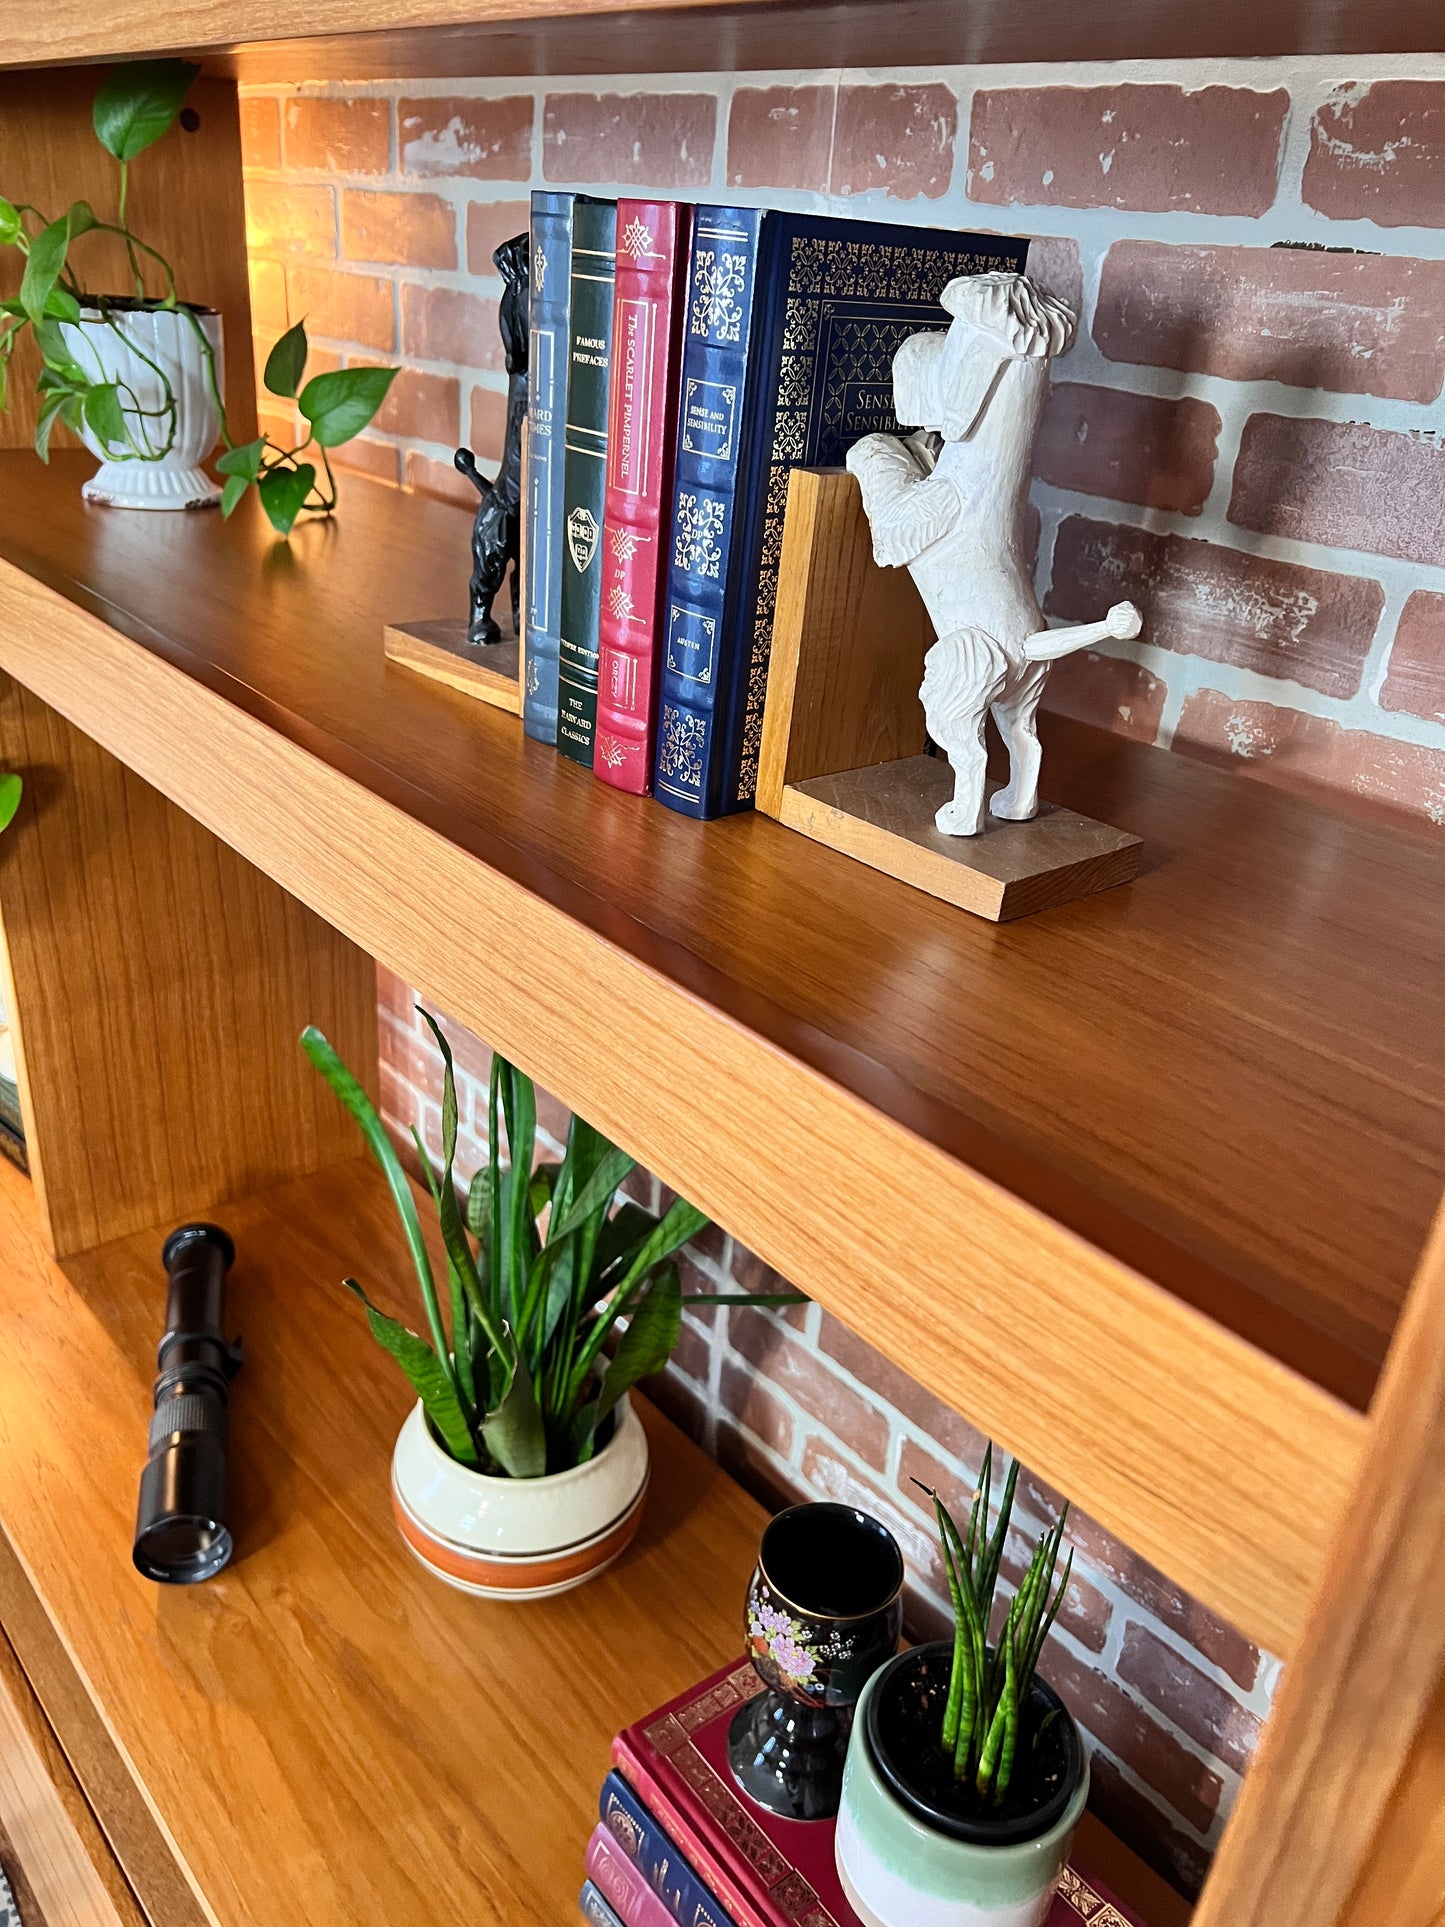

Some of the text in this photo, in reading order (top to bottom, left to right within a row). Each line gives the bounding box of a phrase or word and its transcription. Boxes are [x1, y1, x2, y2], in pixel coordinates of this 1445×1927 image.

[576, 335, 606, 350] FAMOUS
[572, 351, 609, 368] PREFACES
[624, 338, 636, 401] SCARLET
[690, 405, 725, 421] SENSE AND
[687, 418, 727, 435] SENSIBILITY
[621, 404, 633, 479] PIMPERNEL
[676, 636, 701, 651] AUSTEN
[569, 697, 583, 711] THE
[561, 708, 592, 730] HARVARD
[561, 725, 591, 746] CLASSICS
